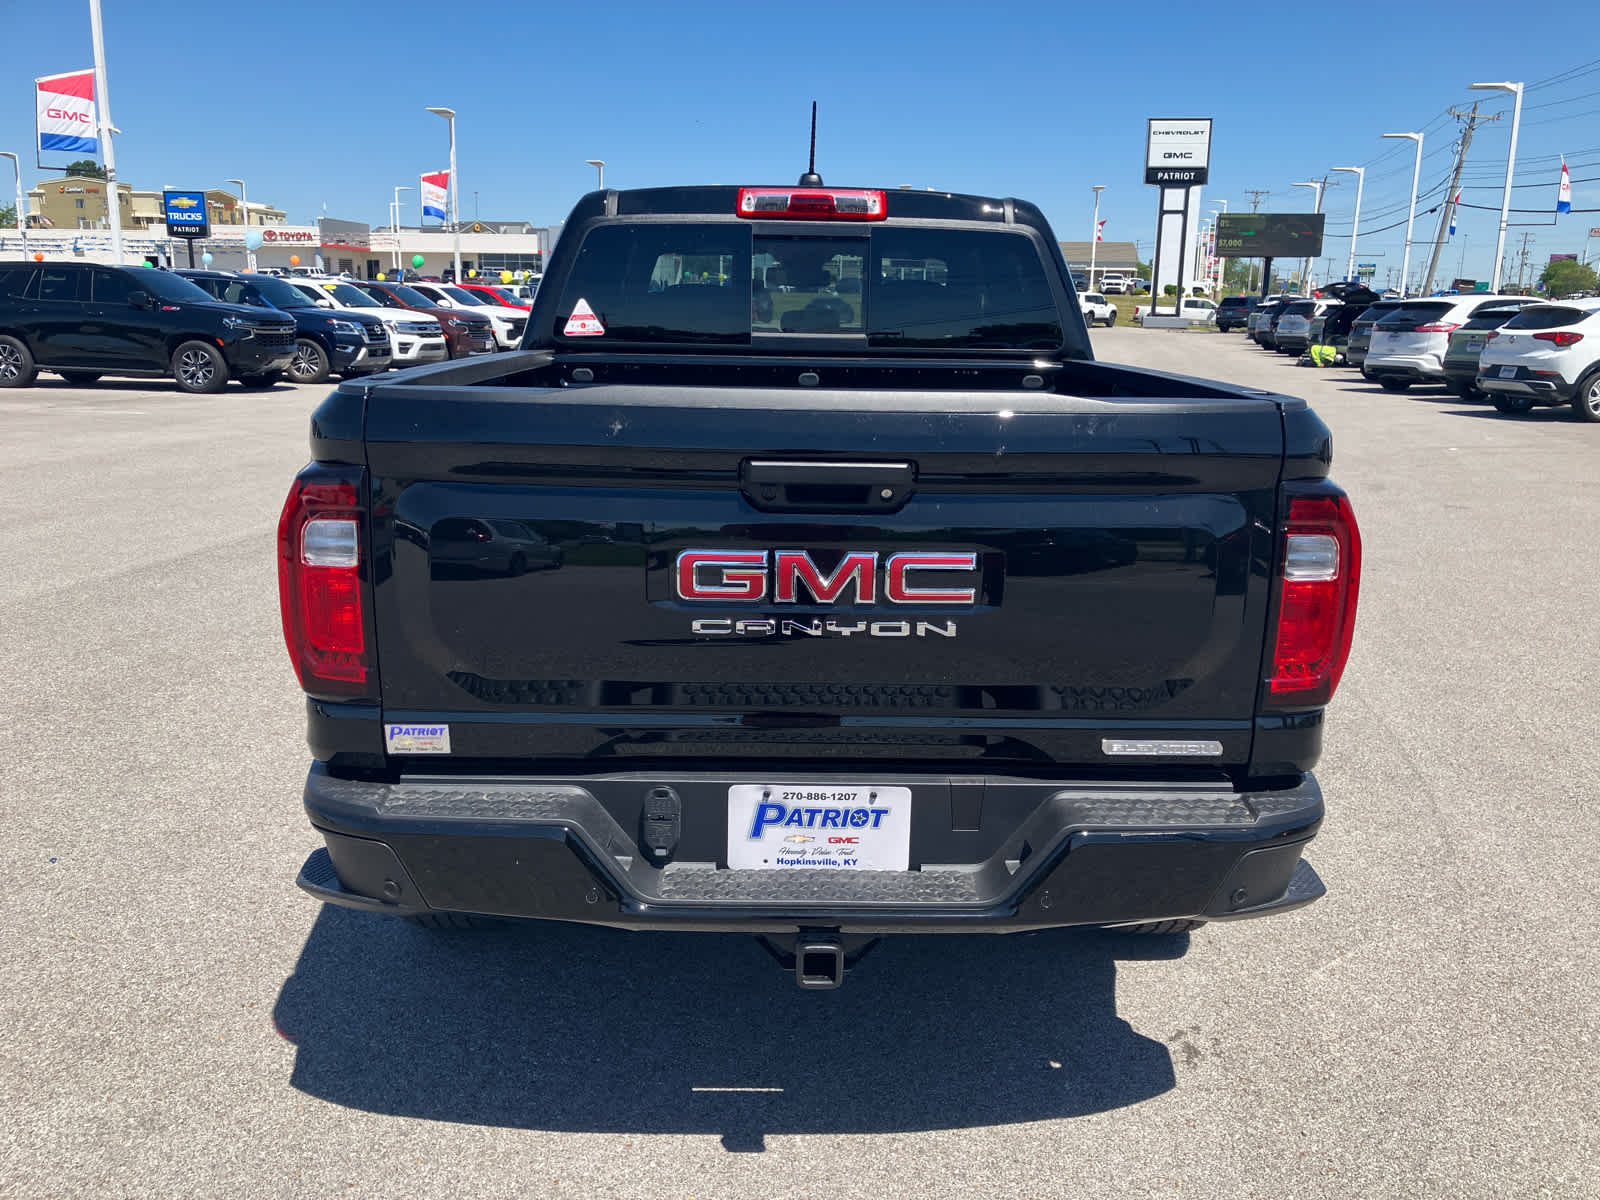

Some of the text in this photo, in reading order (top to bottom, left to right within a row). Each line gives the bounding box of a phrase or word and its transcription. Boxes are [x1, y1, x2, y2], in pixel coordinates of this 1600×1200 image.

[47, 108, 91, 124] GMC
[1157, 172, 1196, 180] PATRIOT
[167, 212, 203, 221] TRUCKS
[278, 231, 313, 240] TOYOTA
[676, 549, 977, 605] GMC
[691, 618, 957, 638] CANYON
[389, 726, 446, 741] PATRIOT
[782, 791, 858, 801] 270-886-1207
[749, 802, 890, 840] PATRIOT
[827, 836, 860, 844] GMC
[776, 857, 858, 867] Hopkinsville, KY
